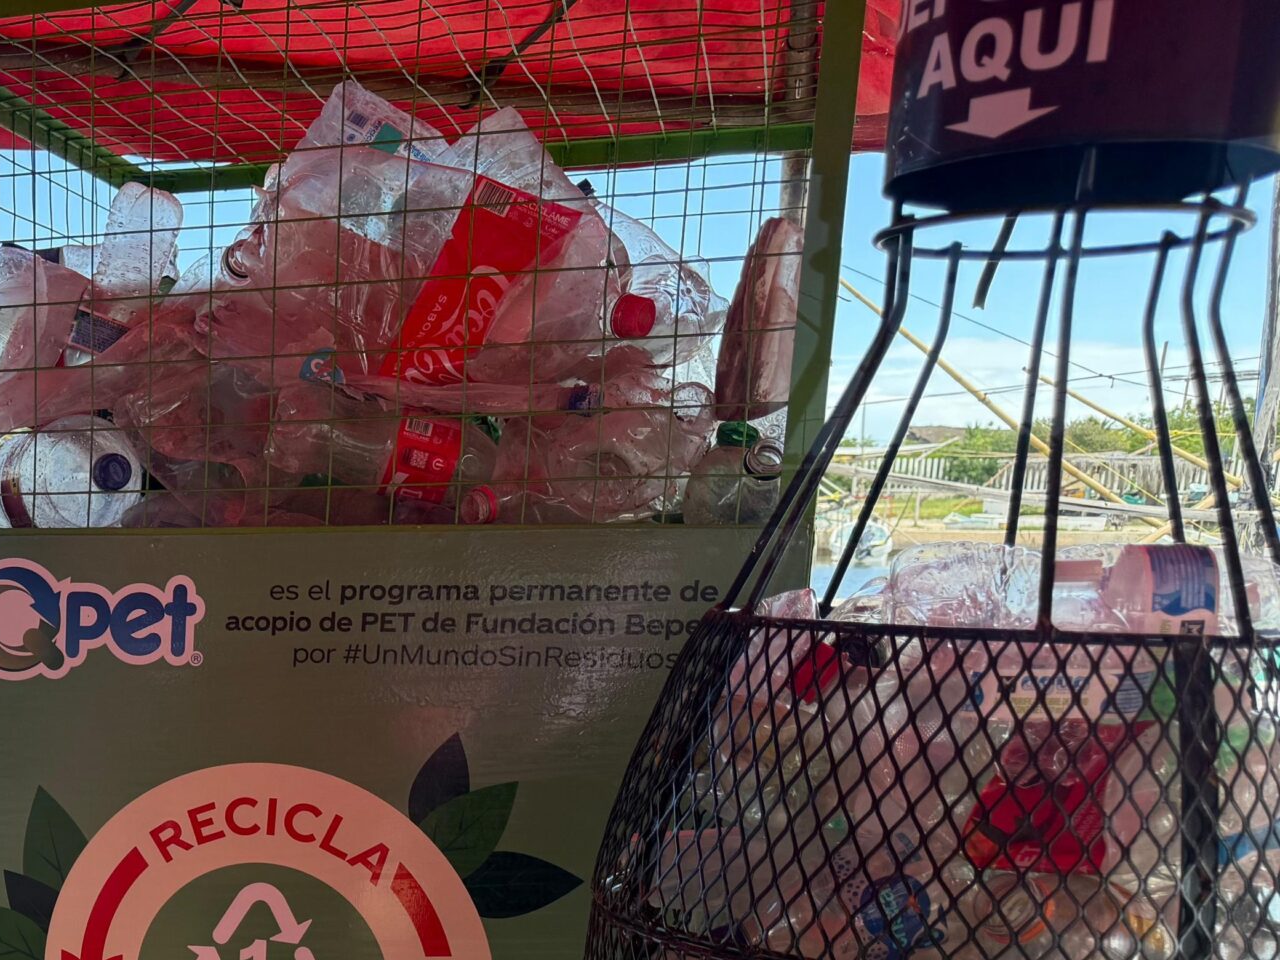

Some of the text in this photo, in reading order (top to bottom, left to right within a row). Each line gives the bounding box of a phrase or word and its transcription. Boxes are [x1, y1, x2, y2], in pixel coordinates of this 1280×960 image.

[269, 580, 720, 607] es el programa permanente de
[225, 614, 312, 636] acopio
[319, 612, 353, 634] de
[361, 613, 415, 634] PET
[422, 612, 457, 635] de
[465, 612, 616, 637] Fundación
[292, 644, 679, 671] por #UnMundoSinResiduos
[148, 797, 391, 887] RECICLA
